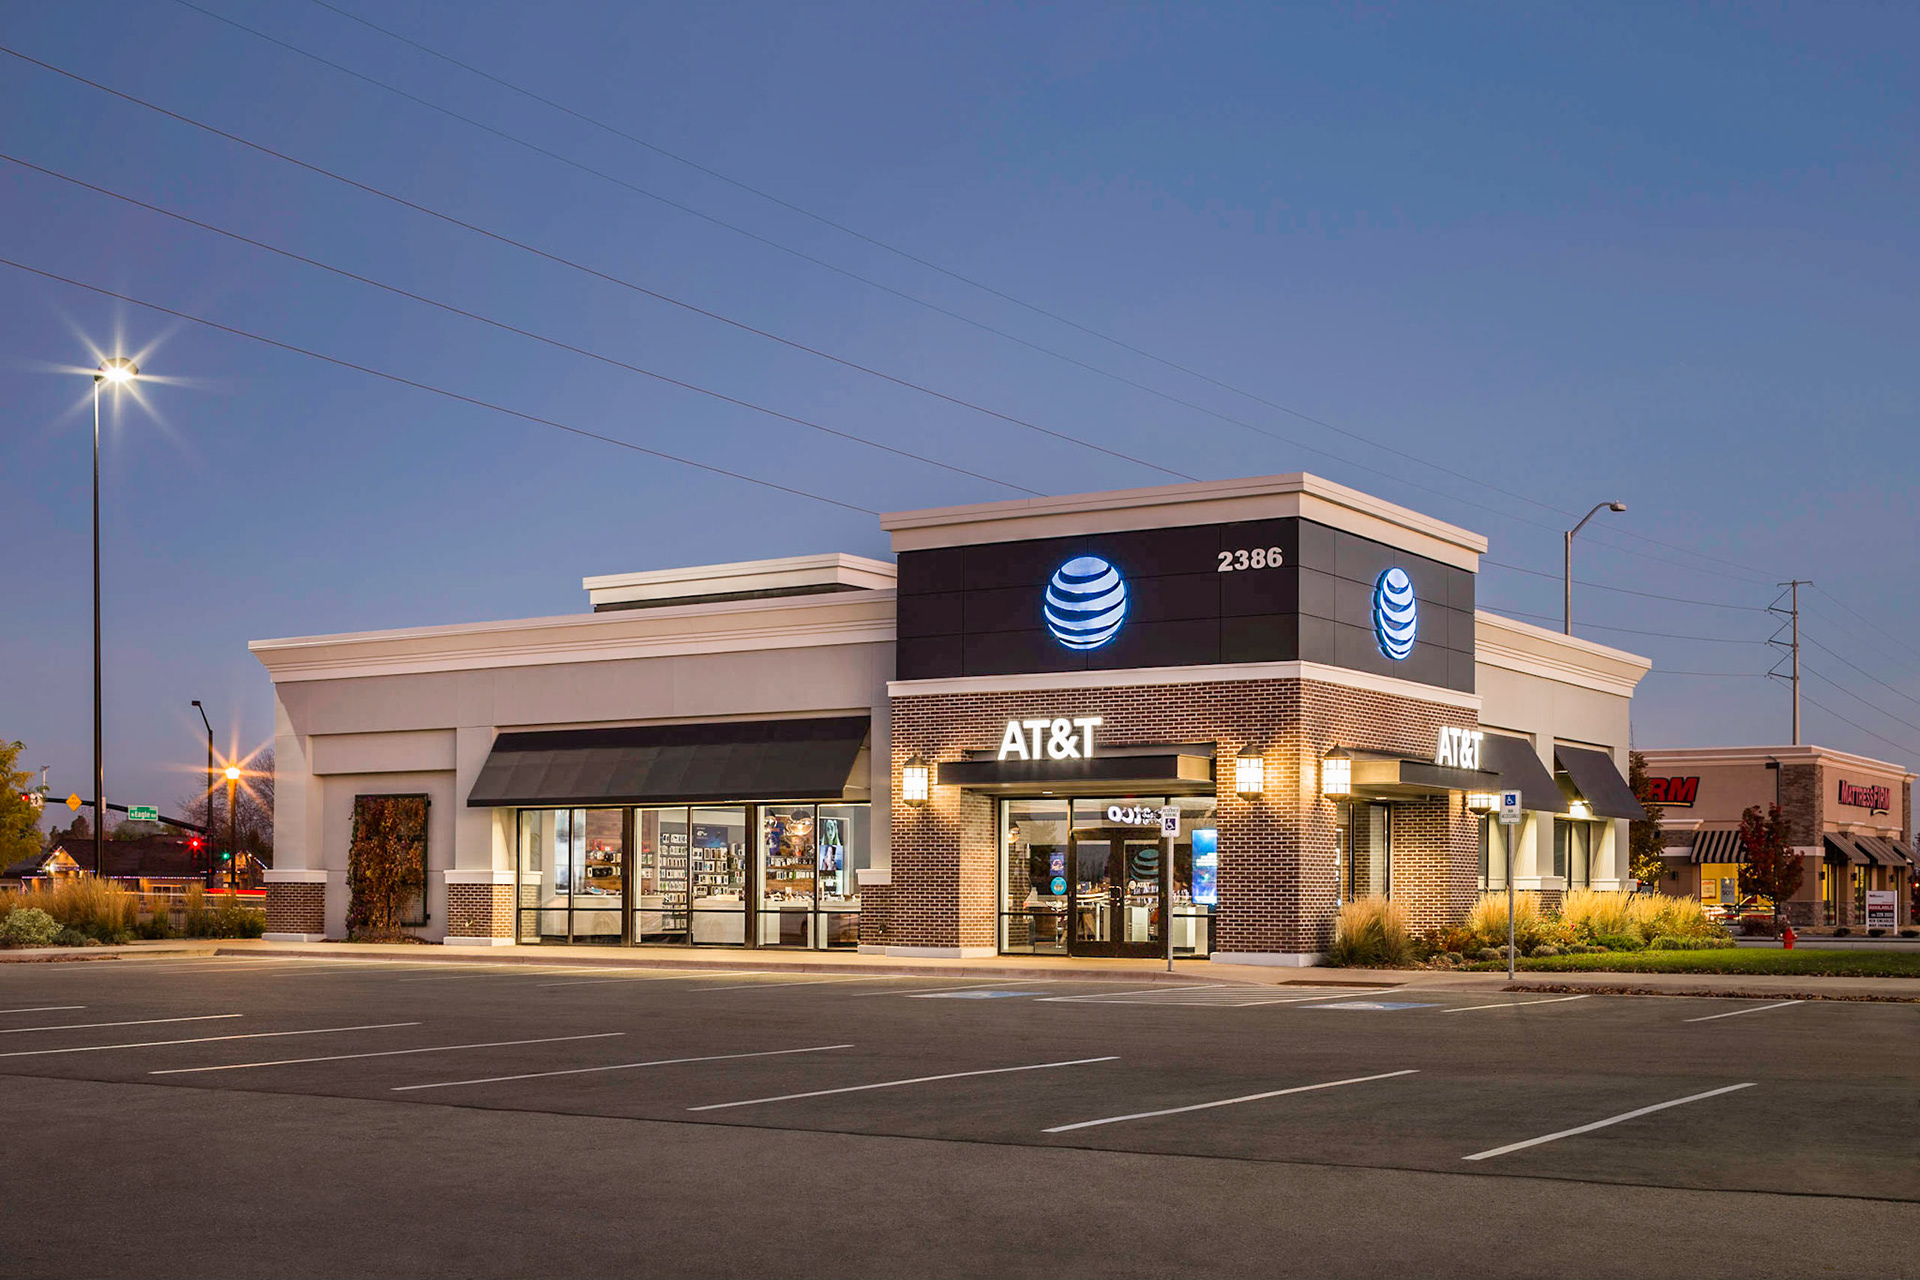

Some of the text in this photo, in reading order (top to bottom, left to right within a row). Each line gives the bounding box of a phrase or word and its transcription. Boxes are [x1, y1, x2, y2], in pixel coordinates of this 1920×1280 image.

[1218, 547, 1283, 572] 2386
[998, 717, 1102, 760] AT&T
[1436, 726, 1483, 770] AT&T
[1637, 776, 1700, 802] RM
